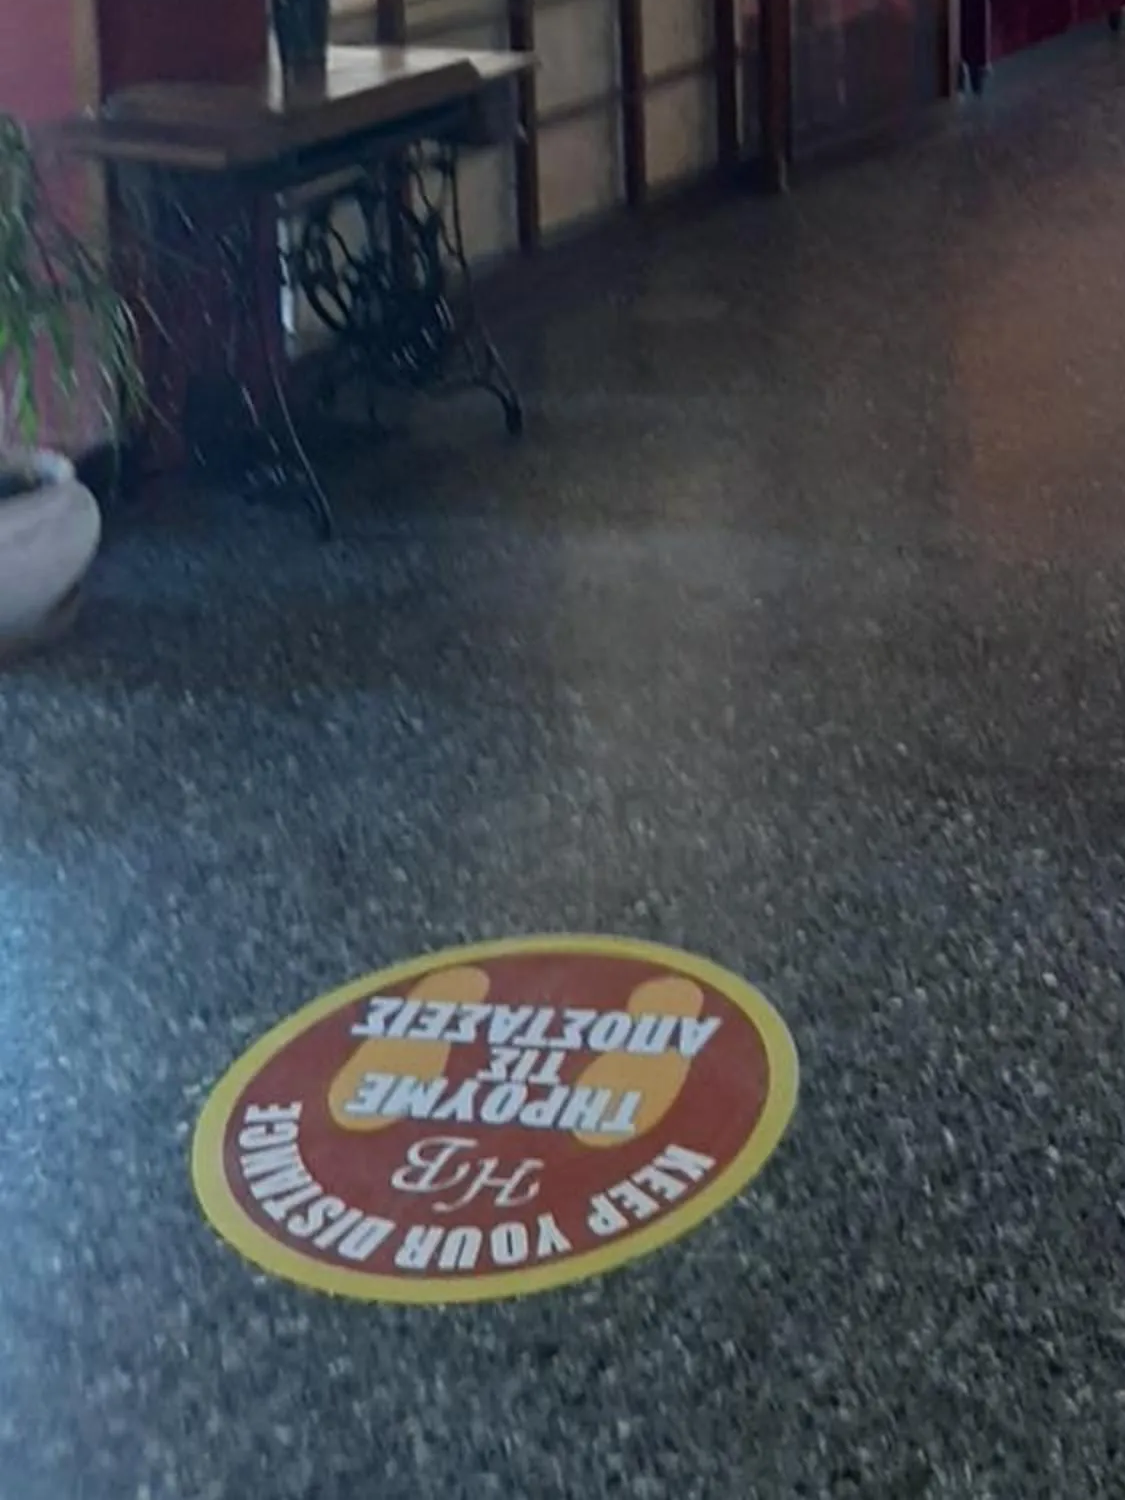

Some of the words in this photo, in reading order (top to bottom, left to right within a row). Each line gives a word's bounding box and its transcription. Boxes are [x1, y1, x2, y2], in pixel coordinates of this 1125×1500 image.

[351, 995, 722, 1058] ΑΠΟΣΤΑΣΕΙΣ
[477, 1046, 567, 1084] ΤΙΣ
[345, 1071, 642, 1135] ΤΗΡΟΥΜΕ
[238, 1101, 395, 1262] DISTANCE
[588, 1143, 716, 1237] KEEP
[394, 1212, 573, 1270] YOUR
